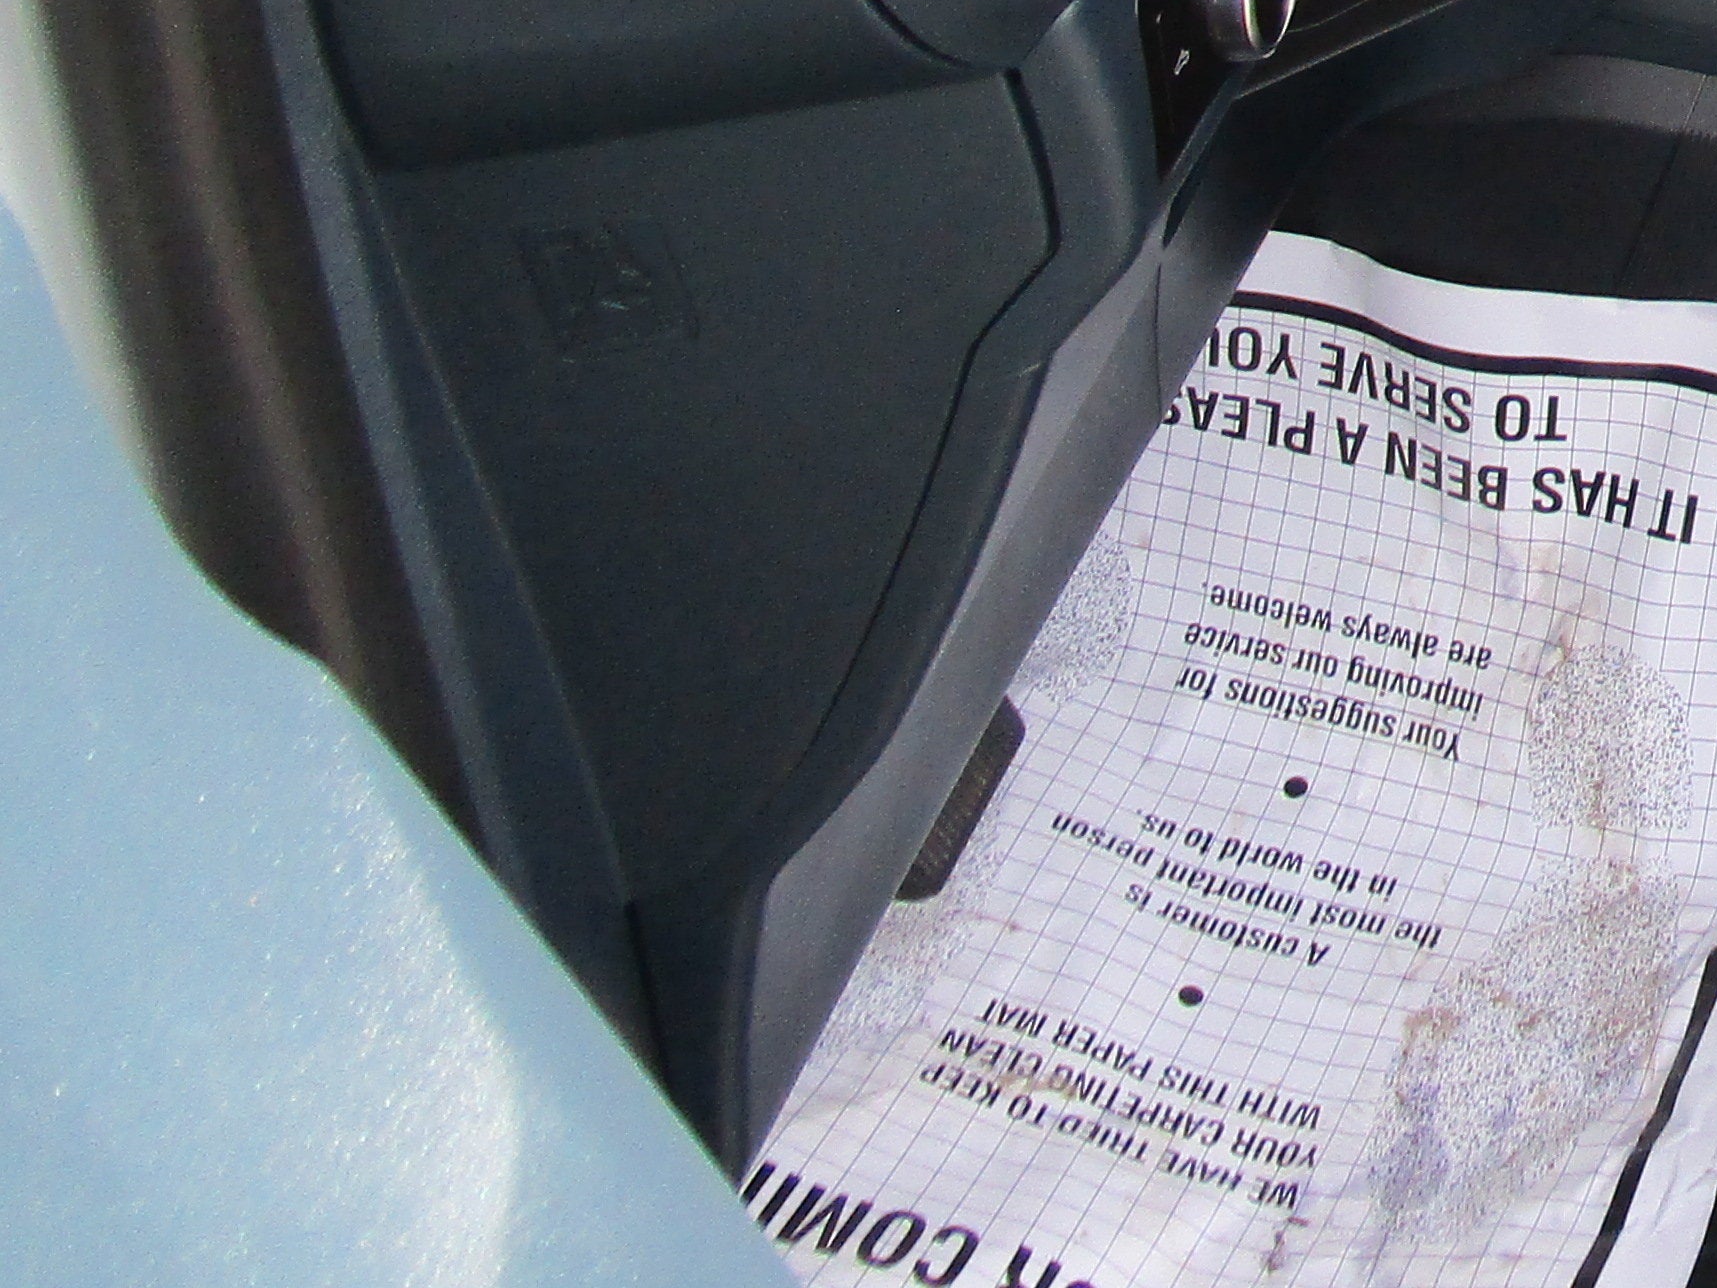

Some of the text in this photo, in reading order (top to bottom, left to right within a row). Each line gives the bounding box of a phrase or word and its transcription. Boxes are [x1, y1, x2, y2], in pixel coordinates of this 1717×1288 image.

[1318, 343, 1472, 433] SERVE
[1494, 395, 1567, 442] TO
[1336, 417, 1368, 465] A
[1384, 431, 1508, 511] BEEN
[1532, 467, 1639, 528] HAS
[1647, 488, 1698, 544] IT
[1202, 582, 1492, 671] are always welcome.
[1175, 667, 1459, 762] Your suggestions for
[1184, 623, 1483, 721] improving our service
[1051, 813, 1441, 949] the most important person
[1136, 809, 1398, 901] in the world to us.
[1125, 884, 1330, 967] A customer is
[938, 1029, 1317, 1168] YOUR CARPETING CLEAN
[974, 999, 1320, 1130] WITH THIS PAPER MAT
[920, 1064, 1299, 1210] WE HAVE TRIED TO KEEP
